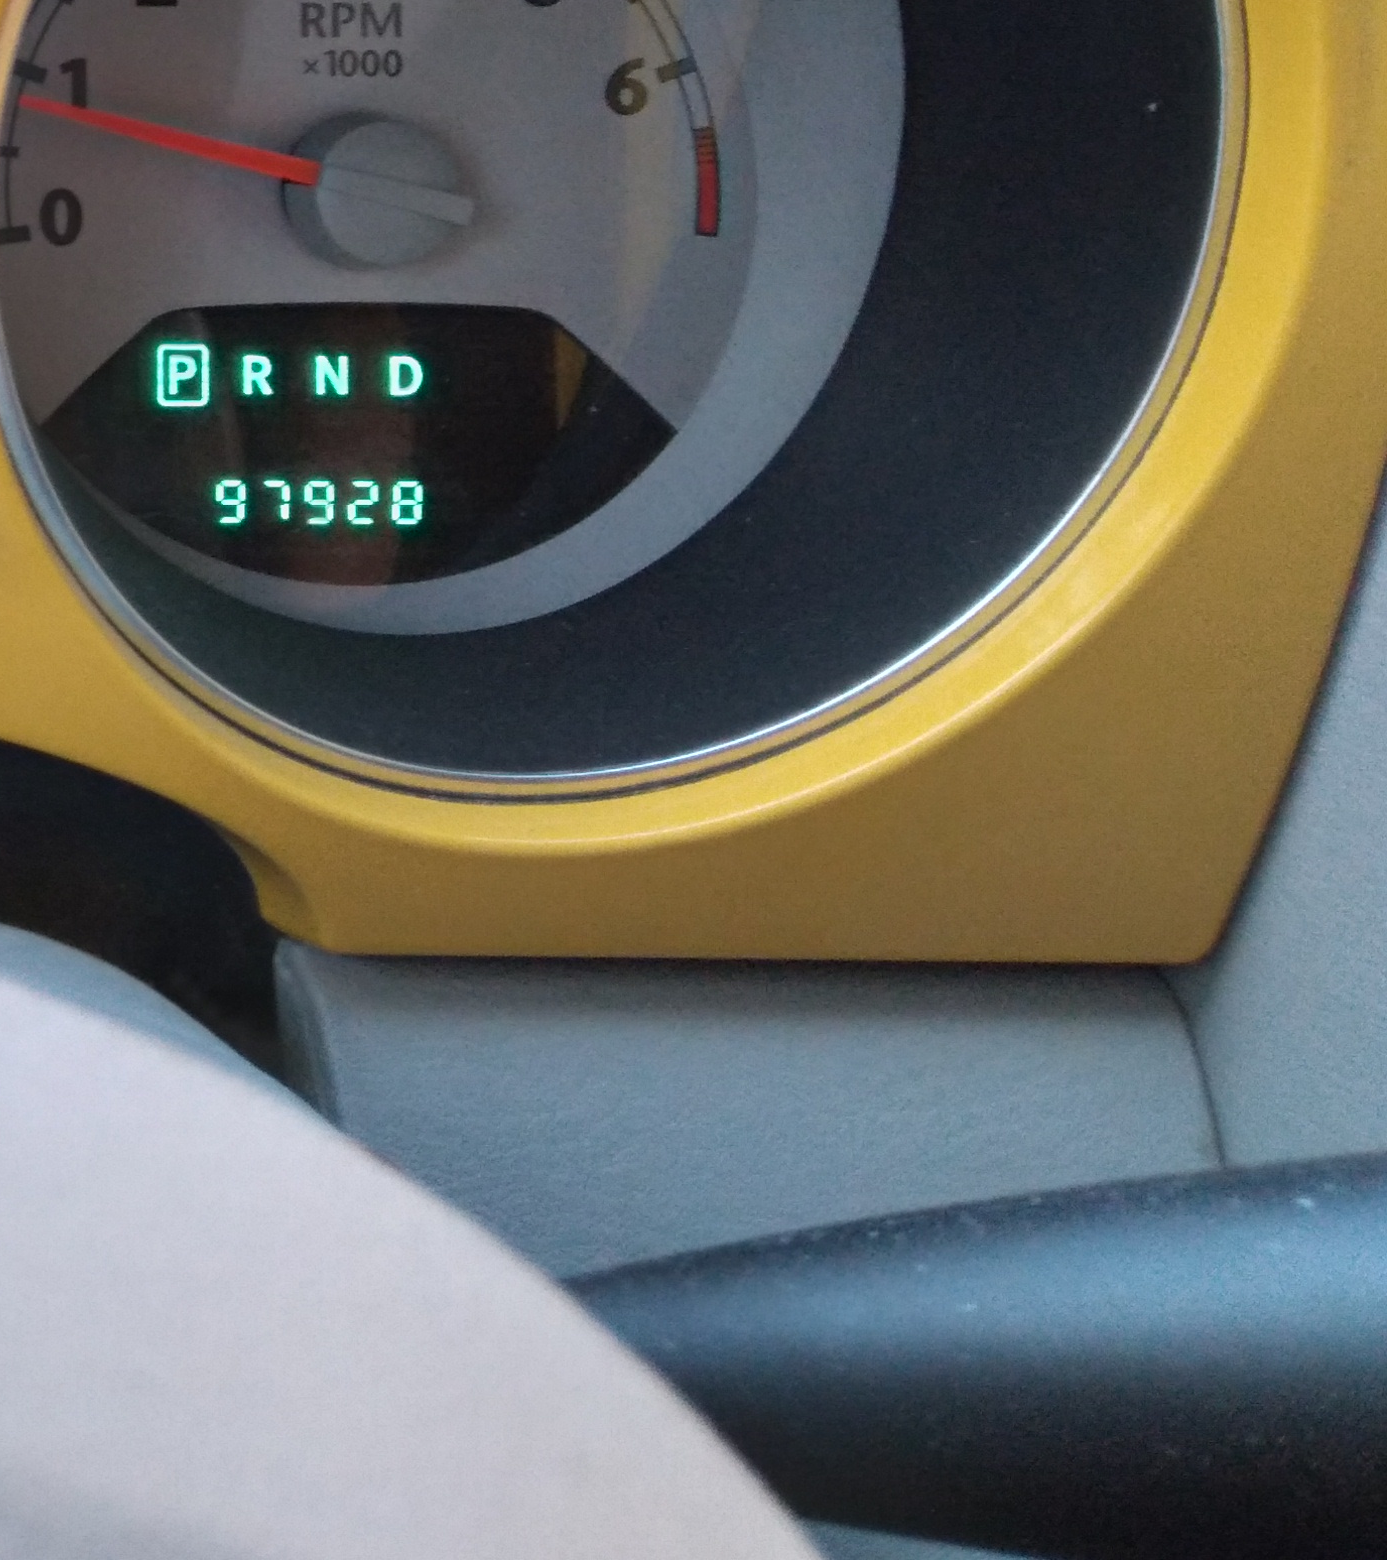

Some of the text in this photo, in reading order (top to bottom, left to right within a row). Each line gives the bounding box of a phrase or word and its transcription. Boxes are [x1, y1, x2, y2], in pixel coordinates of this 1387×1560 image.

[299, 1, 404, 38] RPM
[59, 58, 89, 108] 1
[603, 57, 649, 116] 6
[40, 188, 83, 246] 0
[167, 354, 424, 397] P R N D
[213, 479, 425, 525] 97928
